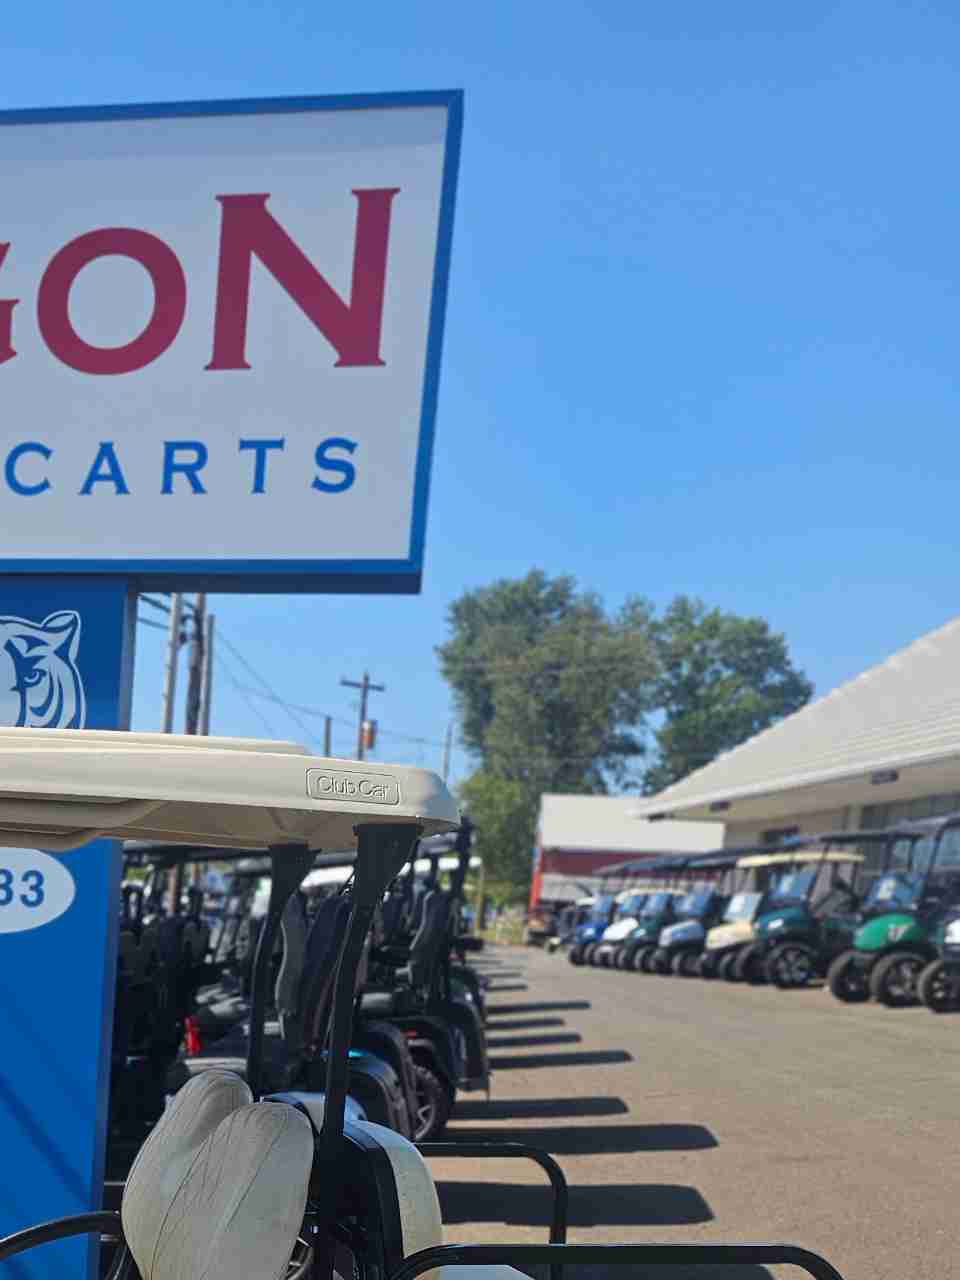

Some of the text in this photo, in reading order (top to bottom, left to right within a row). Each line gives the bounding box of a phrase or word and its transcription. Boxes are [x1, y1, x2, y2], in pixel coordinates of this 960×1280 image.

[3, 437, 359, 497] CARTS
[316, 775, 390, 799] Club Car
